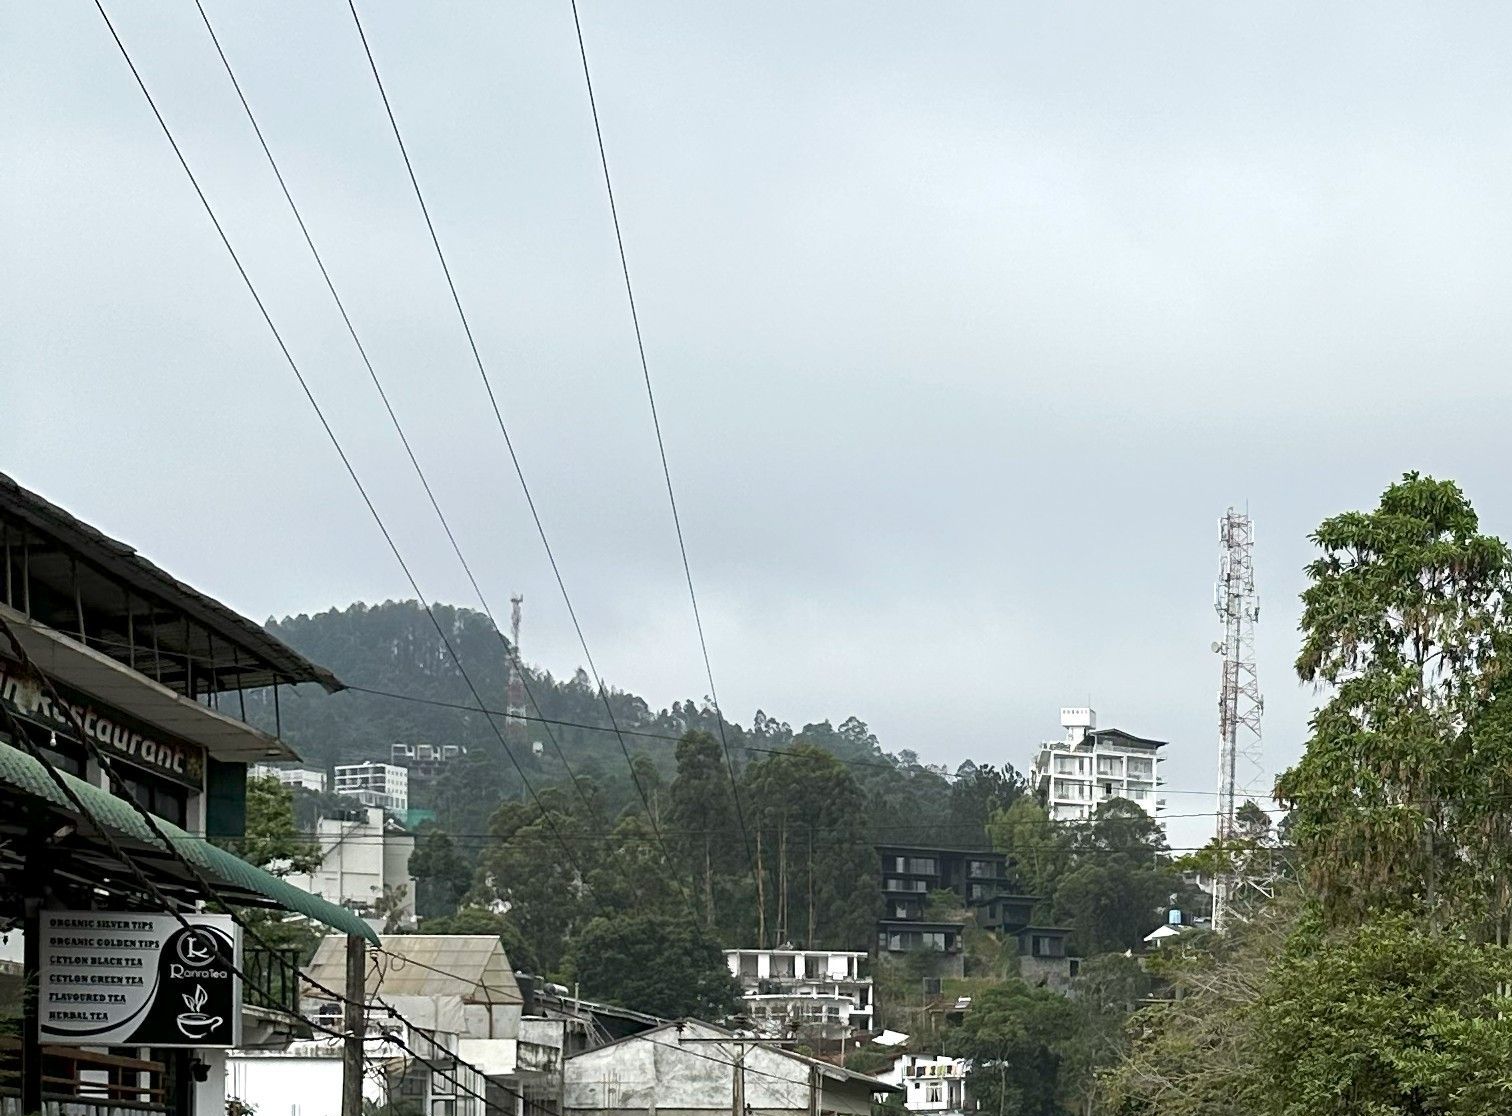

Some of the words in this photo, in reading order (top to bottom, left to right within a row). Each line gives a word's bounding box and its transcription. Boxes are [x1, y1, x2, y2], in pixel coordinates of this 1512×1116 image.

[50, 919, 94, 928] ORGANIC
[132, 921, 154, 930] TIPS
[50, 938, 94, 946] ORGANIC
[97, 939, 136, 947] GOLDEN
[137, 940, 160, 949] TIPS
[50, 956, 88, 965] CEYLON
[91, 957, 122, 966] BLACK
[125, 958, 143, 966] TEA
[50, 974, 88, 983] CEYLON
[91, 975, 123, 984] GREEN
[125, 976, 144, 985] TEA
[49, 993, 106, 1002] FLAVOURED
[108, 994, 126, 1003] TEA
[49, 1011, 88, 1019] HERBAL
[90, 1012, 109, 1020] TEA
